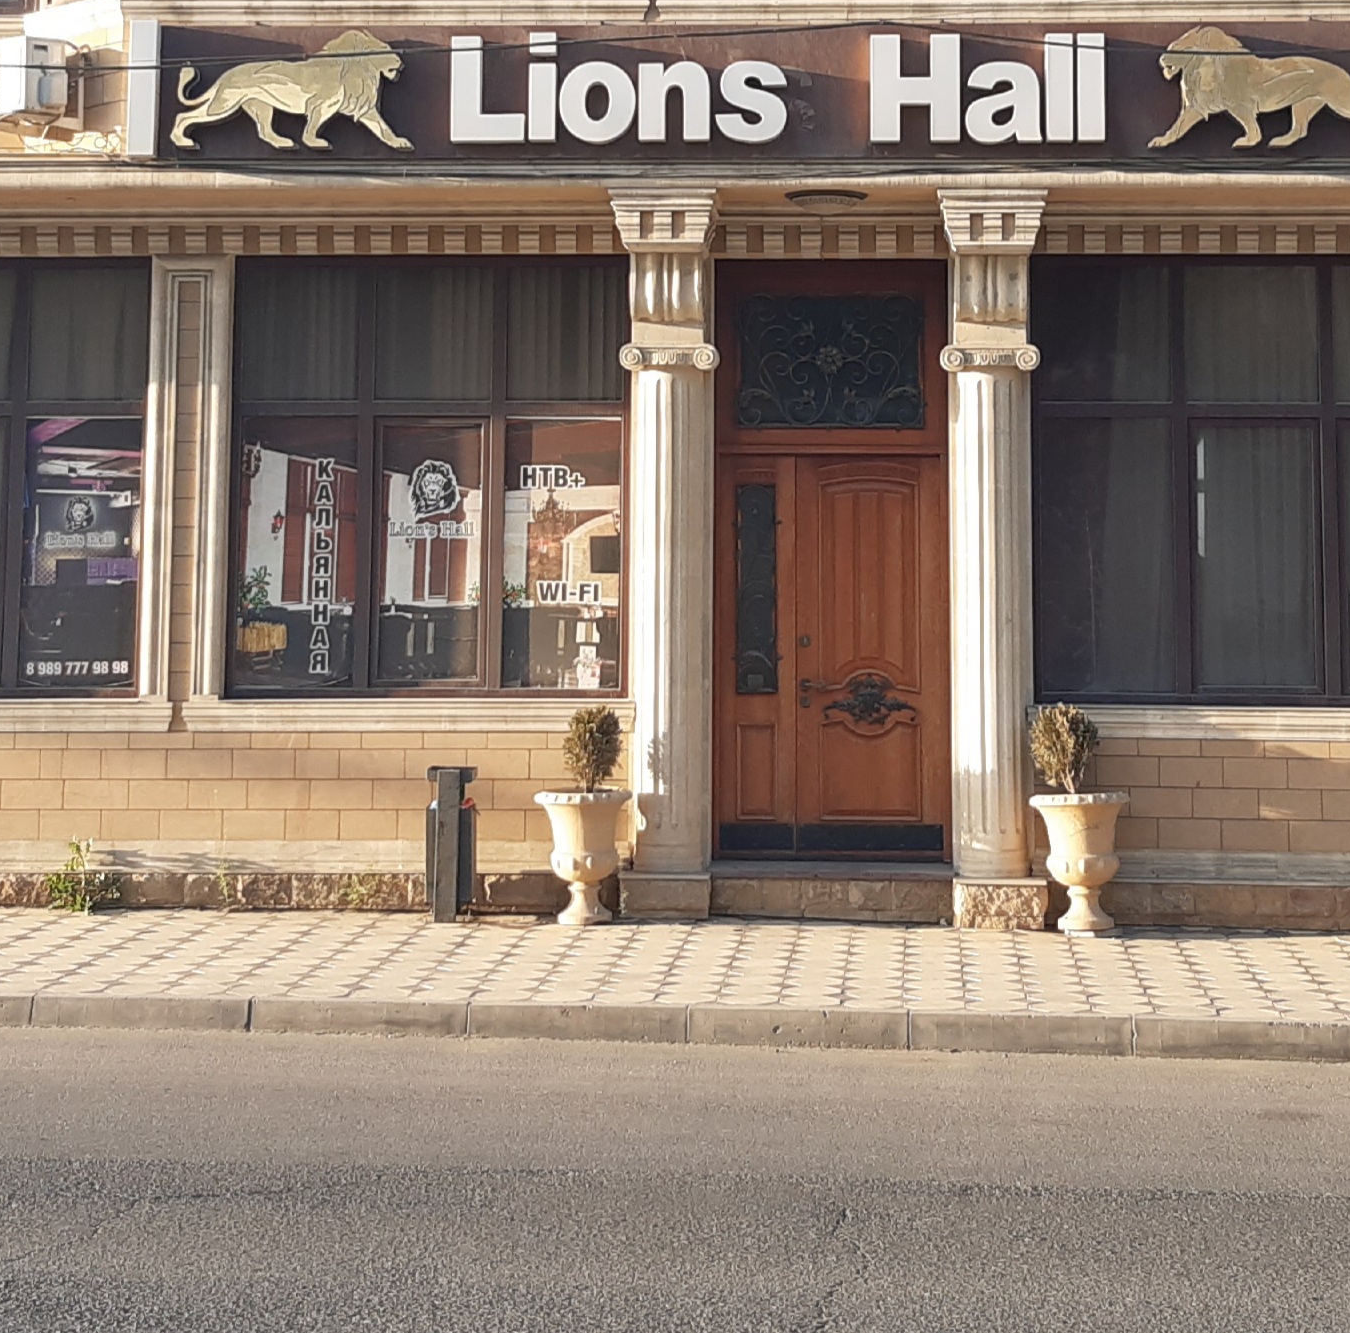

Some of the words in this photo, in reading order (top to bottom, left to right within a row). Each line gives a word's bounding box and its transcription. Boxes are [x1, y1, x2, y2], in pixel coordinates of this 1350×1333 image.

[450, 32, 788, 145] Lions
[869, 32, 1106, 145] Hall
[521, 466, 585, 489] НТВ+
[389, 521, 437, 538] Lion's
[441, 521, 475, 537] Hall
[308, 457, 336, 674] КАЛЬЯННАЯ
[536, 581, 601, 604] WI-FI
[26, 663, 34, 675] 8
[38, 662, 62, 675] 989
[65, 661, 89, 675] 777
[92, 661, 109, 674] 98
[112, 660, 129, 674] 98
